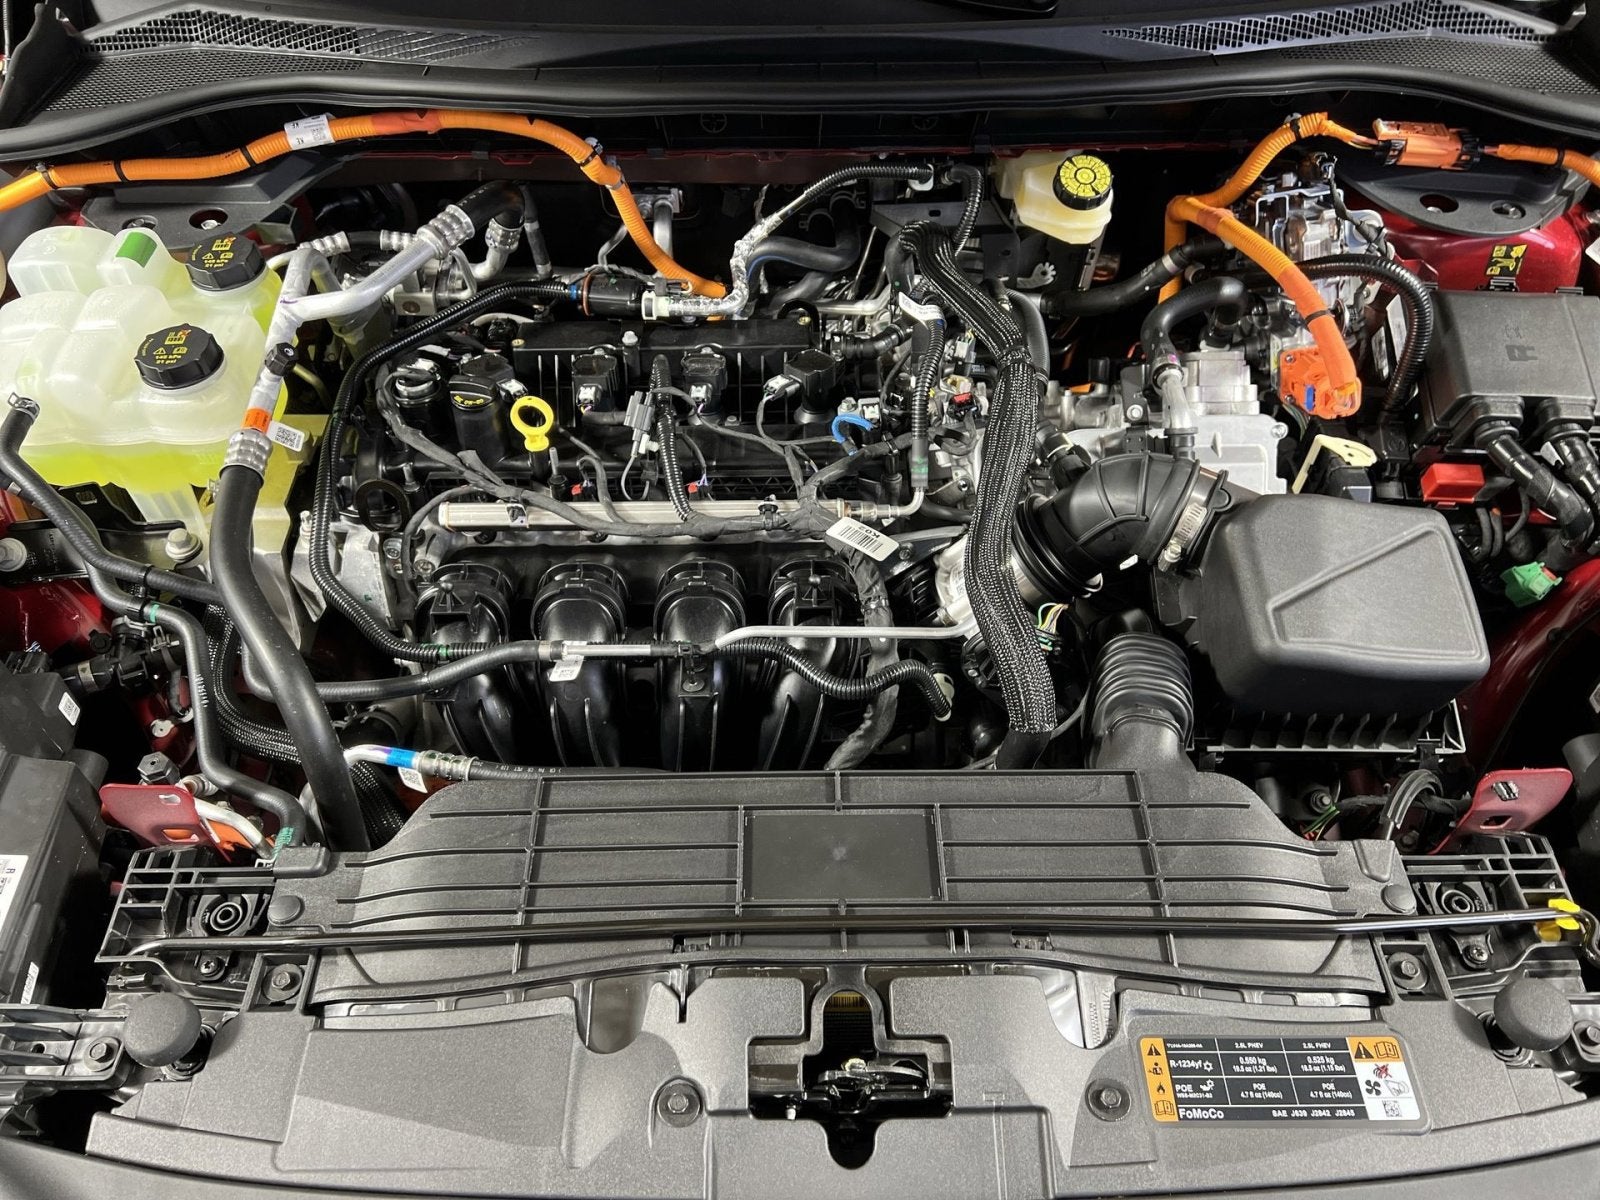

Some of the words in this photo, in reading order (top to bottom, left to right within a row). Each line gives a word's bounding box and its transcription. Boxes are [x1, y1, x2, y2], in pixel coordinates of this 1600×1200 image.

[1169, 1059, 1202, 1070] R-1234yf
[1239, 1056, 1257, 1065] 0.550
[1257, 1056, 1267, 1066] kg
[1306, 1055, 1325, 1064] 0.525
[1325, 1055, 1335, 1065] kg
[1175, 1084, 1193, 1093] POE
[1179, 1108, 1225, 1119] FoMoCo
[1272, 1109, 1289, 1117] SAE
